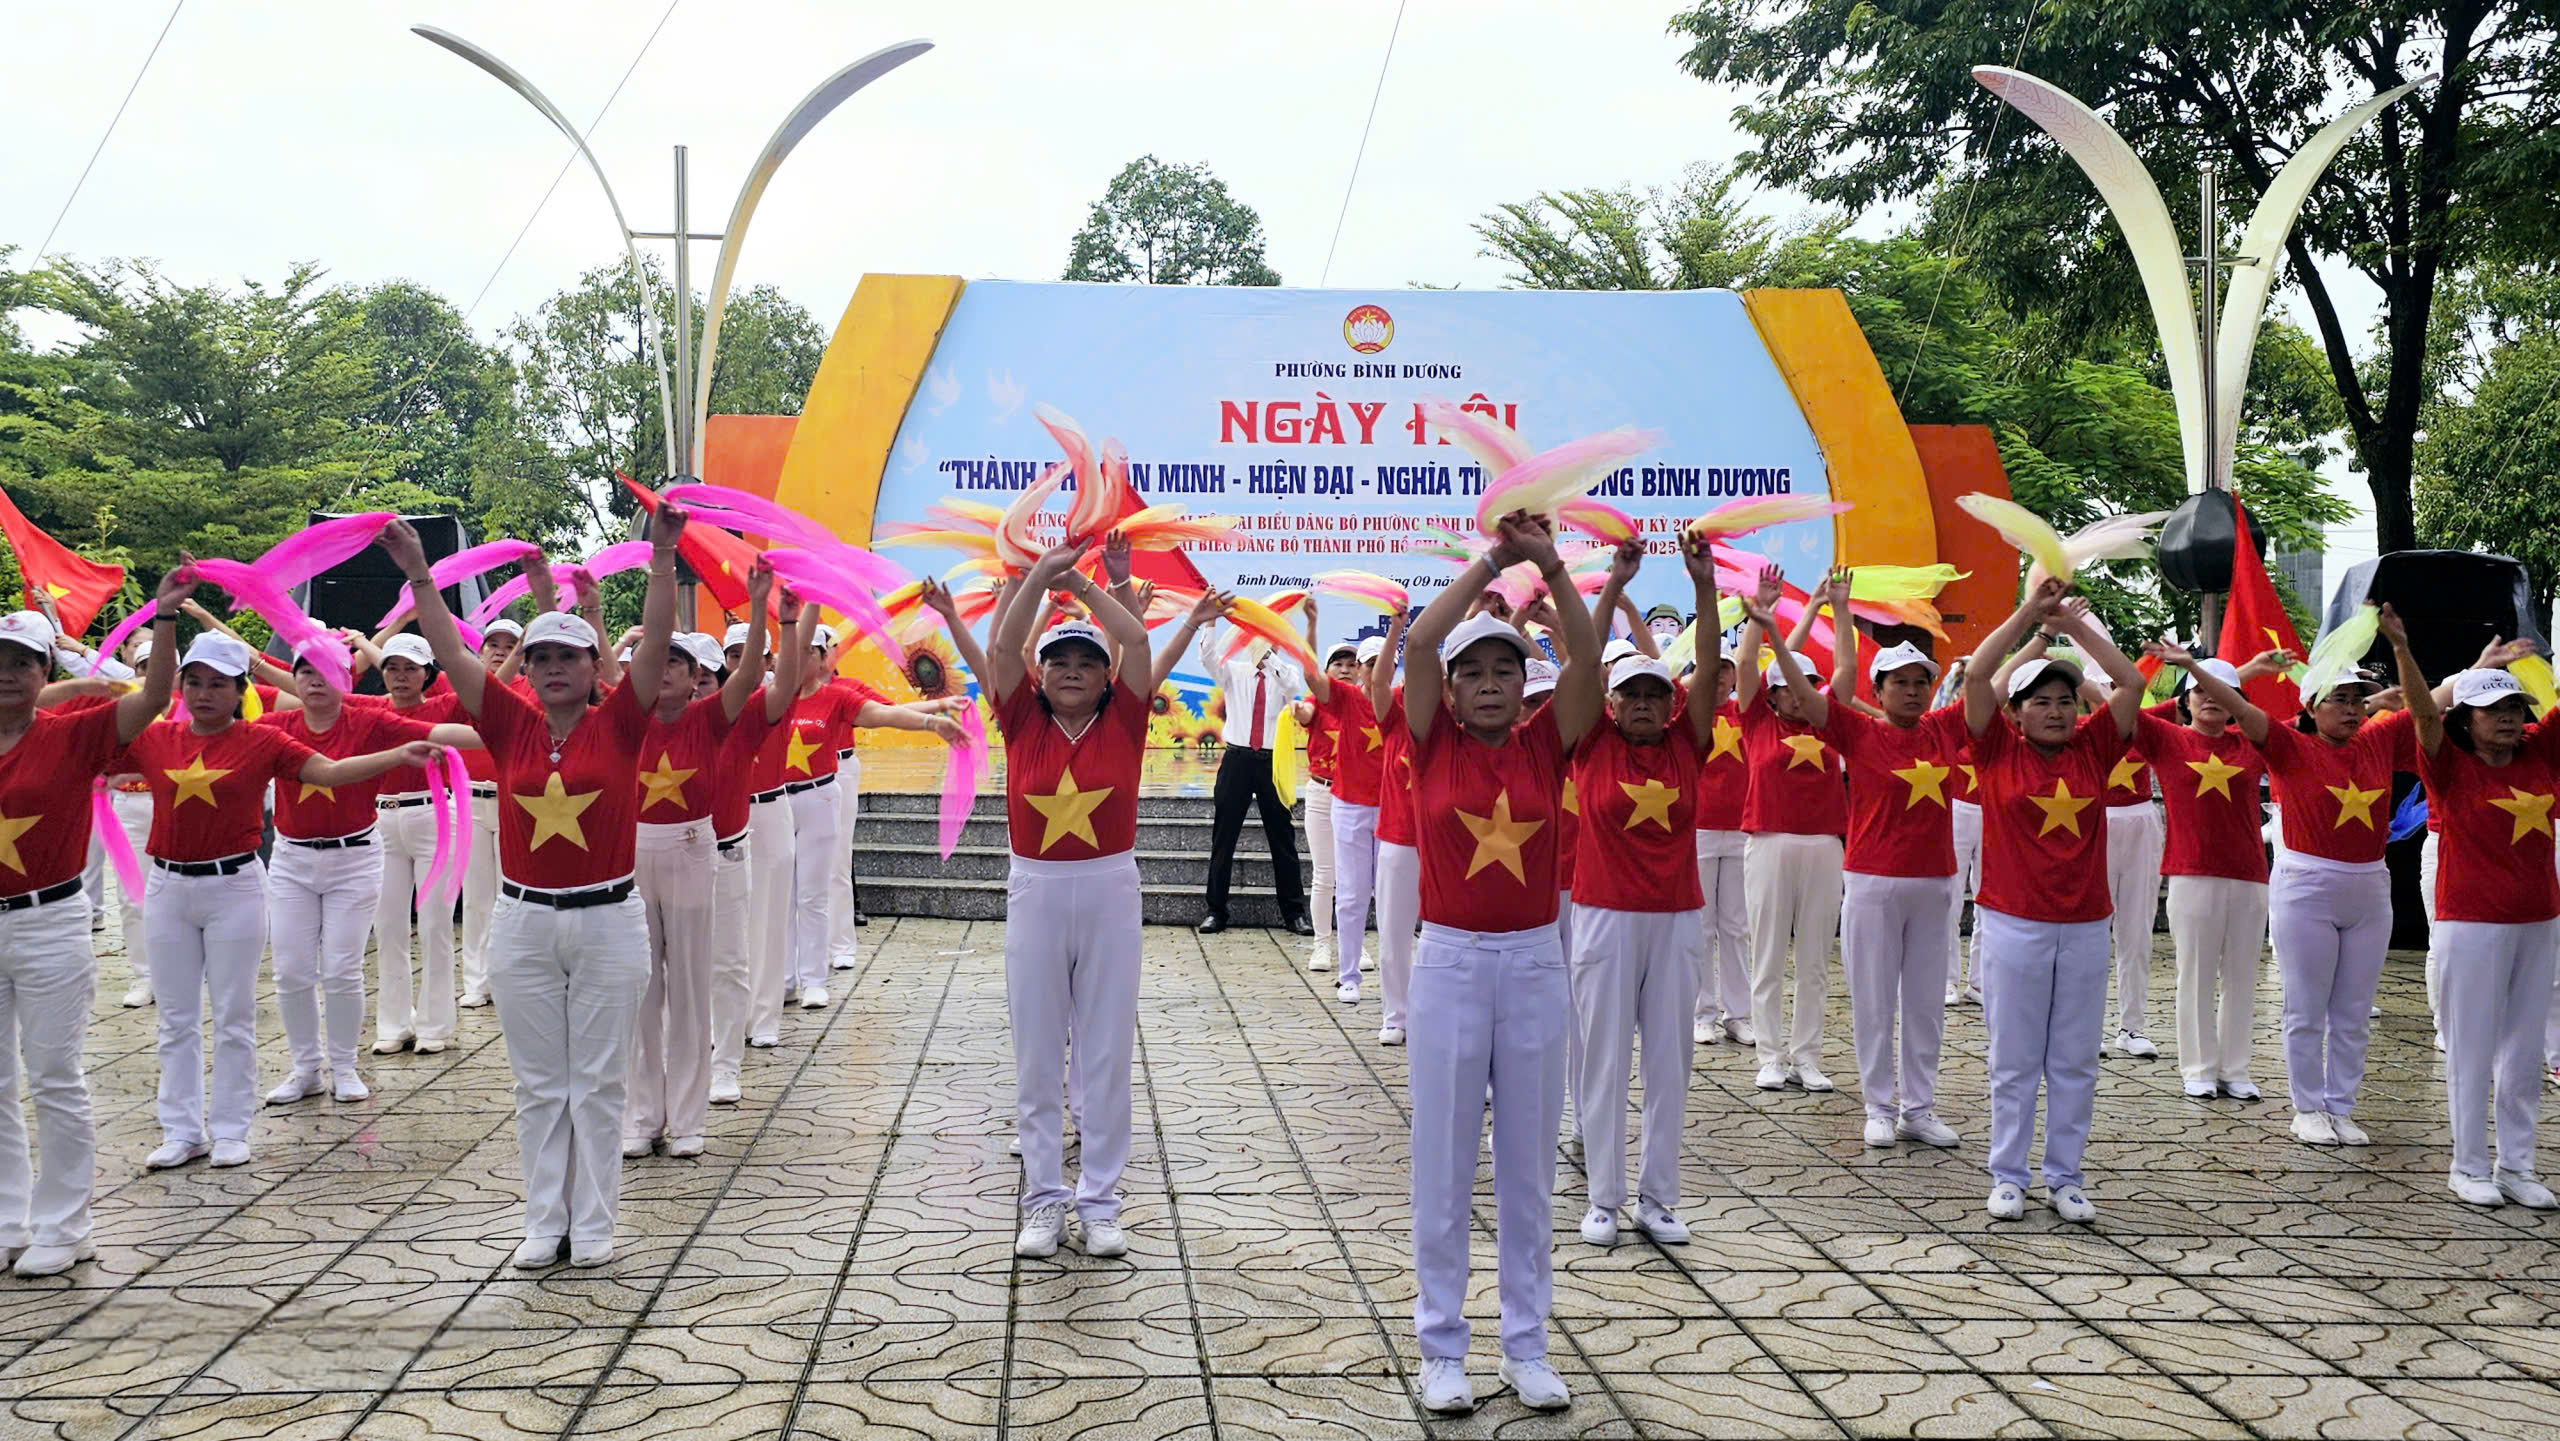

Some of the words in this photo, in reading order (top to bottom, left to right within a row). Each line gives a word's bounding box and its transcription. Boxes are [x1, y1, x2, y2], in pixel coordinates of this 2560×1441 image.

[1275, 361, 1346, 378] PHƯỜNG
[1353, 361, 1397, 379] BÌNH
[1403, 364, 1462, 379] DƯƠNG
[1220, 391, 1387, 445] NGÀY
[1159, 464, 1225, 493] MINH
[1249, 459, 1306, 499] HIỆN
[1314, 466, 1354, 499] ĐẠI
[1377, 461, 1451, 495] NGHĨA
[1642, 462, 1700, 496] BÌNH
[1707, 468, 1791, 496] DƯƠNG
[1257, 510, 1291, 530] BIỂU
[1296, 512, 1334, 530] ĐẢNG
[1339, 513, 1358, 533] BỘ
[1649, 515, 1668, 532] KỲ
[1280, 535, 1298, 555] BỘ
[1303, 535, 1351, 553] THÀNH
[1357, 535, 1386, 553] PHỐ
[1412, 575, 1431, 587] 09
